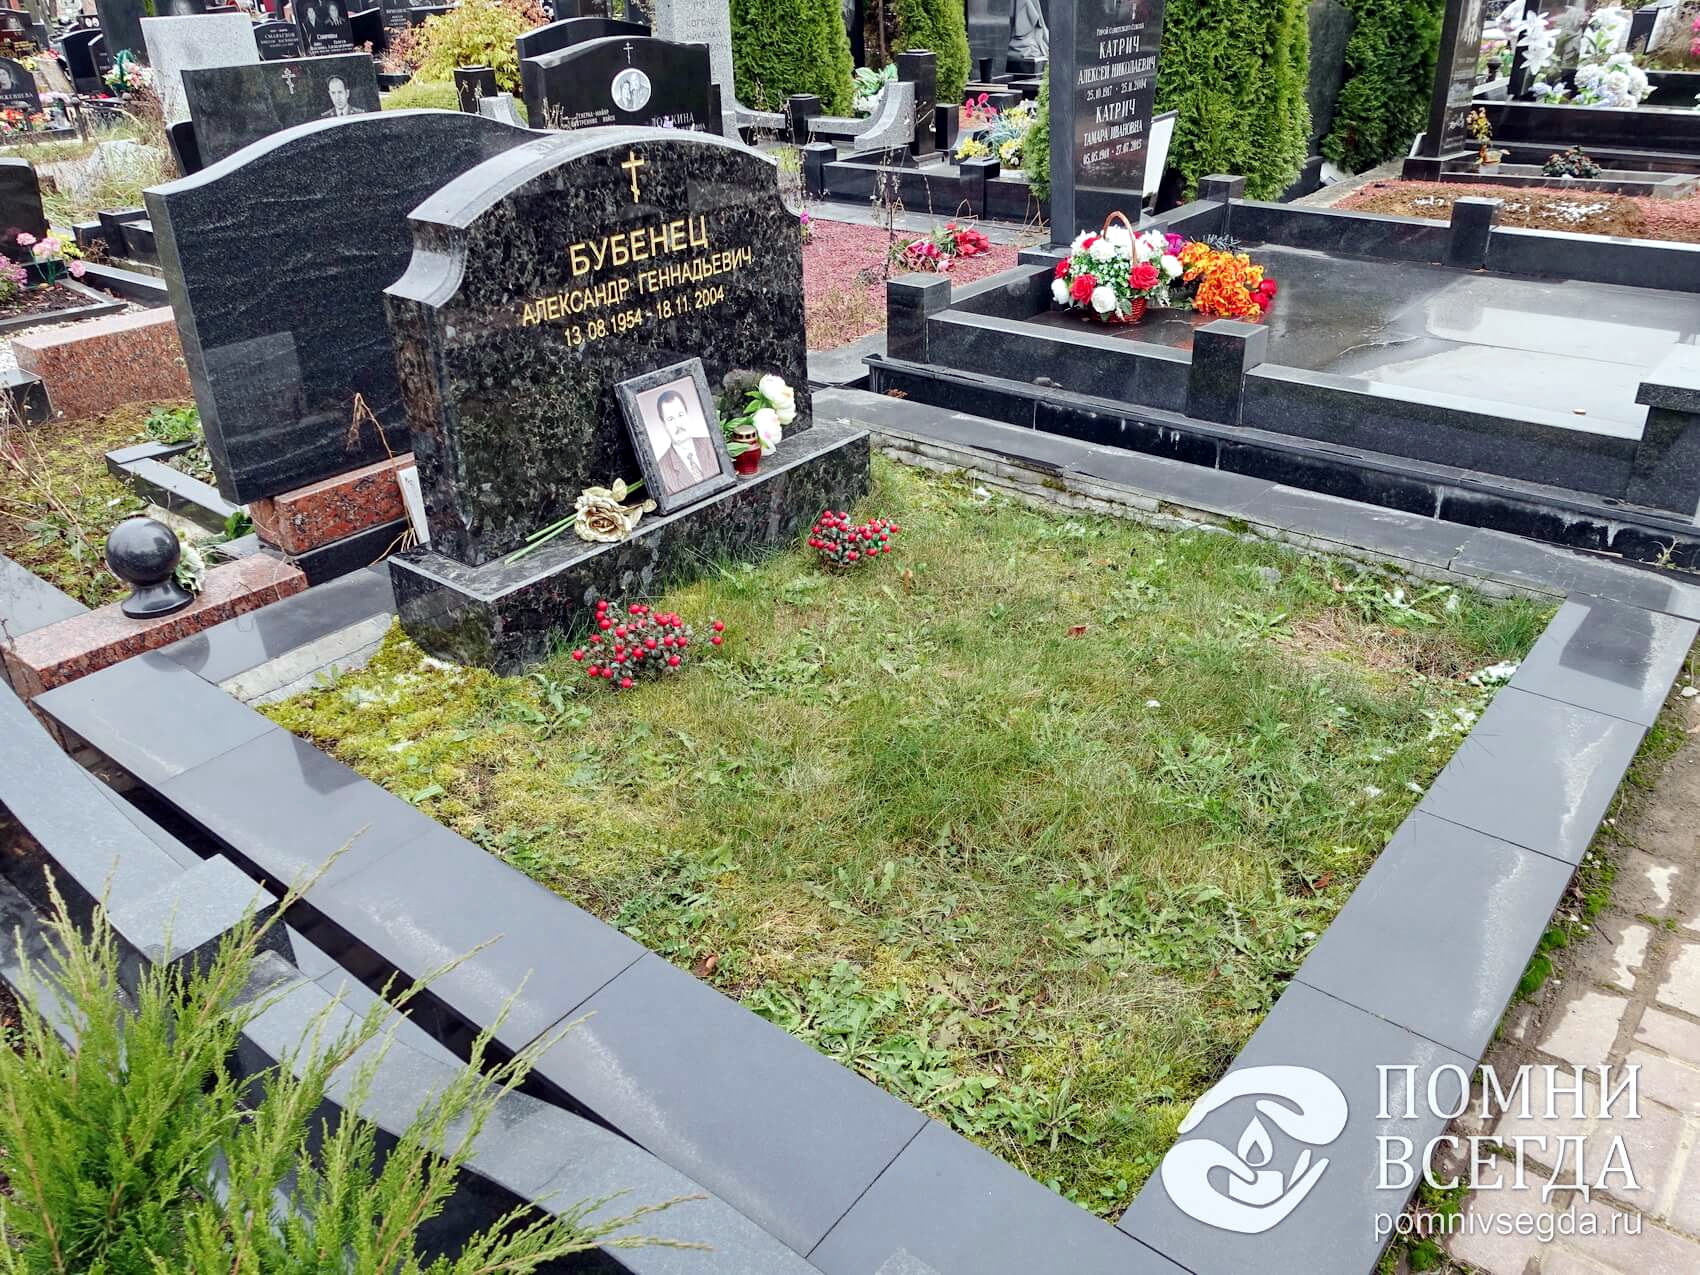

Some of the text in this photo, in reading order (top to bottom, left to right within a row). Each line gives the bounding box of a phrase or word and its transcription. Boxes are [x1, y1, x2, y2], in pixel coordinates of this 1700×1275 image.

[1099, 35, 1140, 60] КАТРИЧ
[1078, 56, 1156, 86] АЛЕКСЕЙ НИКОЛАЕВИЧ
[1095, 98, 1136, 124] КАТРИЧ
[1083, 119, 1143, 148] ТАМАРА ИВАНОВНА
[569, 215, 709, 276] БУБЕНЕЦ
[522, 246, 752, 327] АЛЕКСАНДР ГЕННАДЬЕВИЧ
